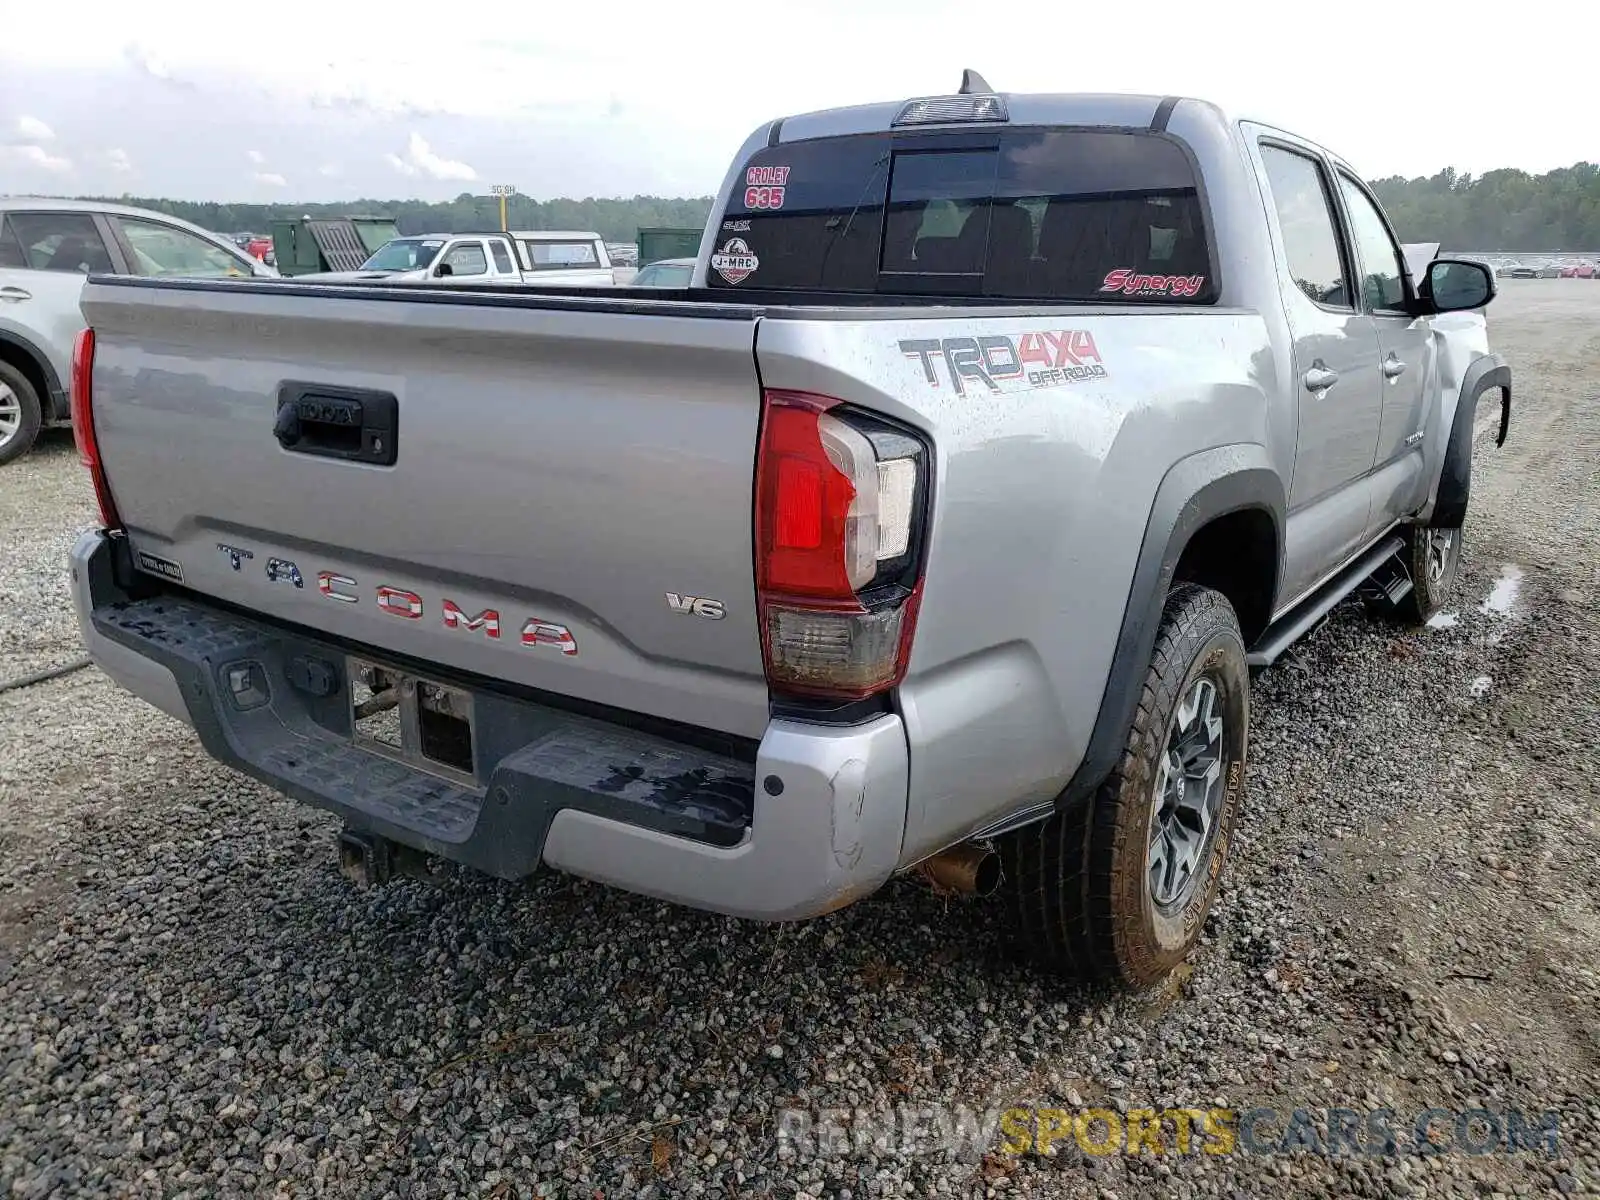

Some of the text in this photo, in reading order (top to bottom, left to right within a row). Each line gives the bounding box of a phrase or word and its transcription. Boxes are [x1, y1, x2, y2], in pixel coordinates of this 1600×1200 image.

[746, 166, 791, 186] CROLEY
[744, 186, 786, 209] 635
[717, 256, 753, 269] J-MRC
[1099, 269, 1205, 297] Synergy
[897, 334, 1025, 397] TRD
[1027, 363, 1109, 386] OFF ROAD
[300, 401, 353, 424] TOYOTA
[216, 543, 580, 656] TACOMA
[665, 591, 728, 621] V6
